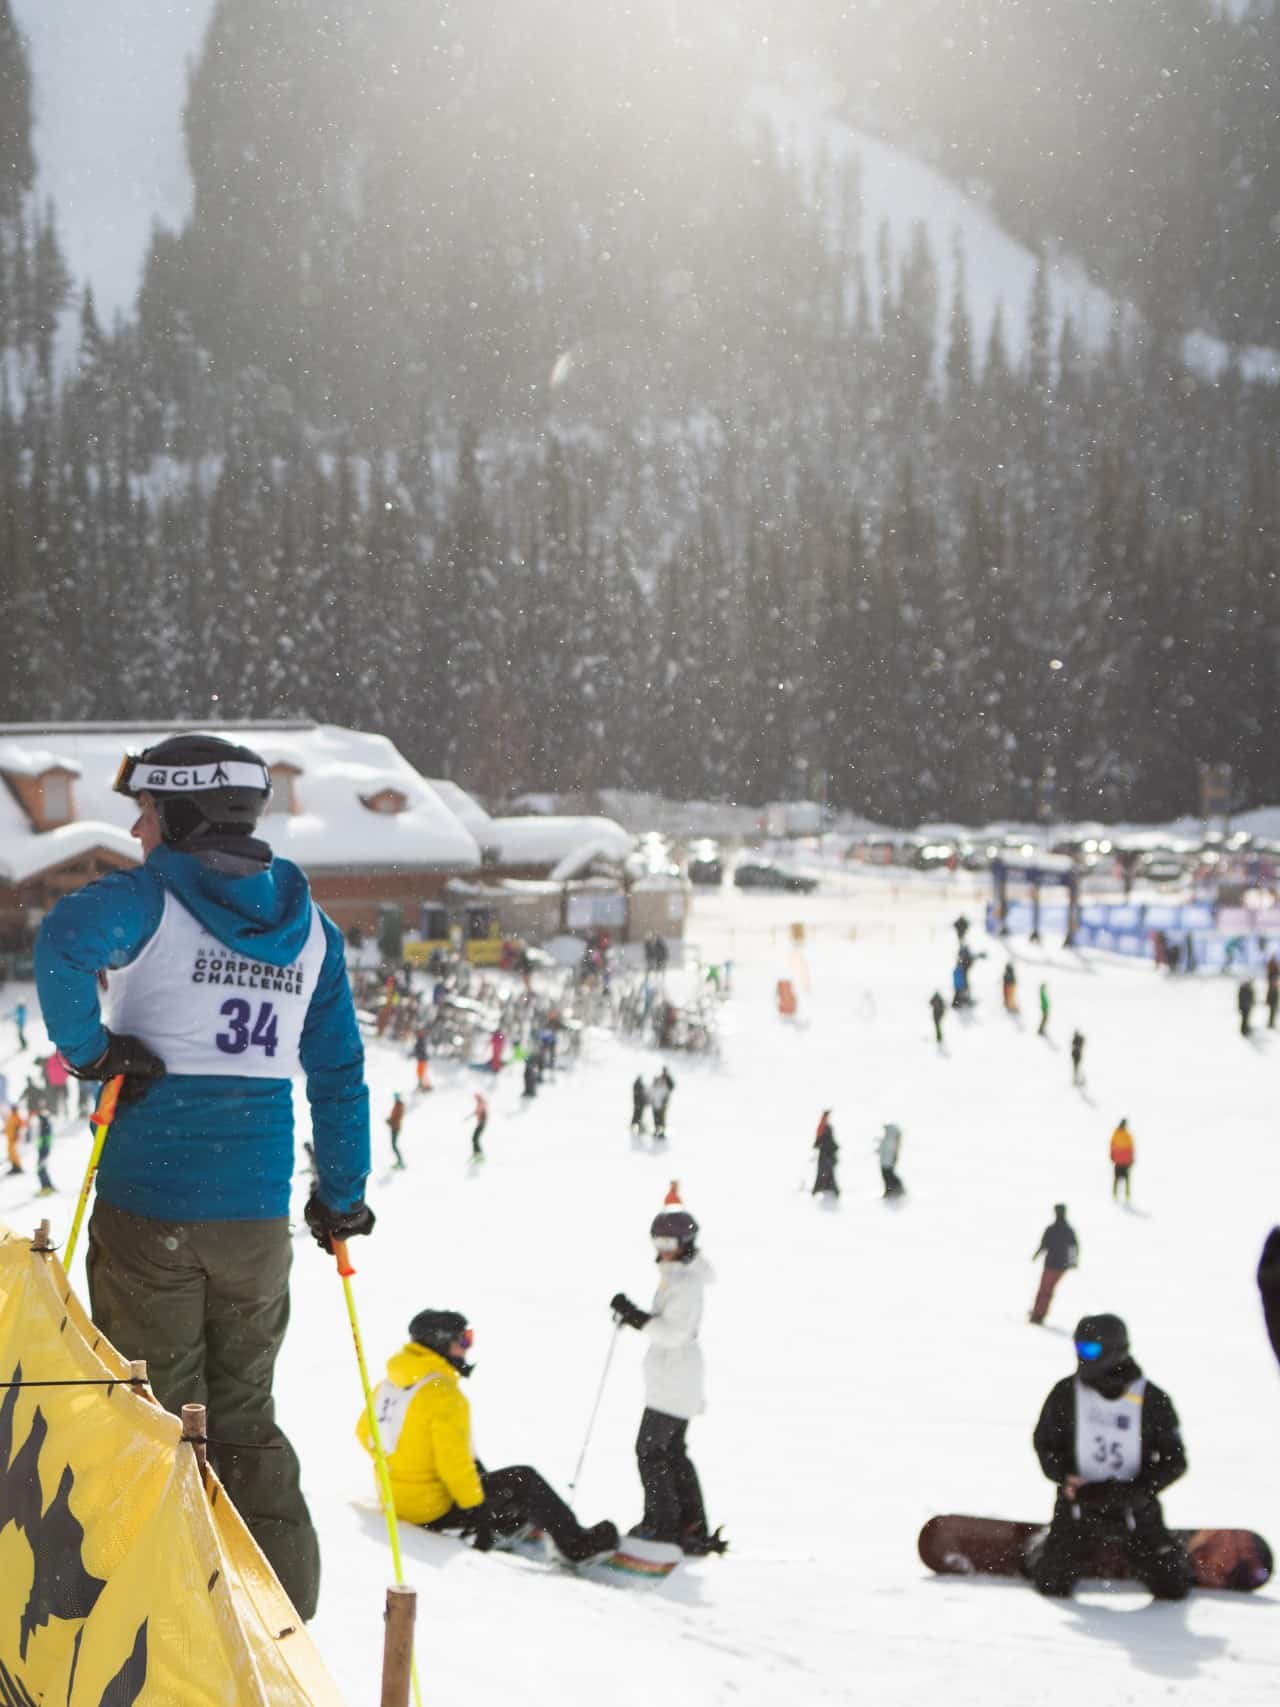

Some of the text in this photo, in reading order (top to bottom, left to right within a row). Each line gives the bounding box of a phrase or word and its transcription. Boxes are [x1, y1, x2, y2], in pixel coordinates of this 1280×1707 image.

[192, 971, 303, 996] CHALLENGE
[194, 958, 305, 984] CORPORATE
[216, 998, 278, 1057] 34
